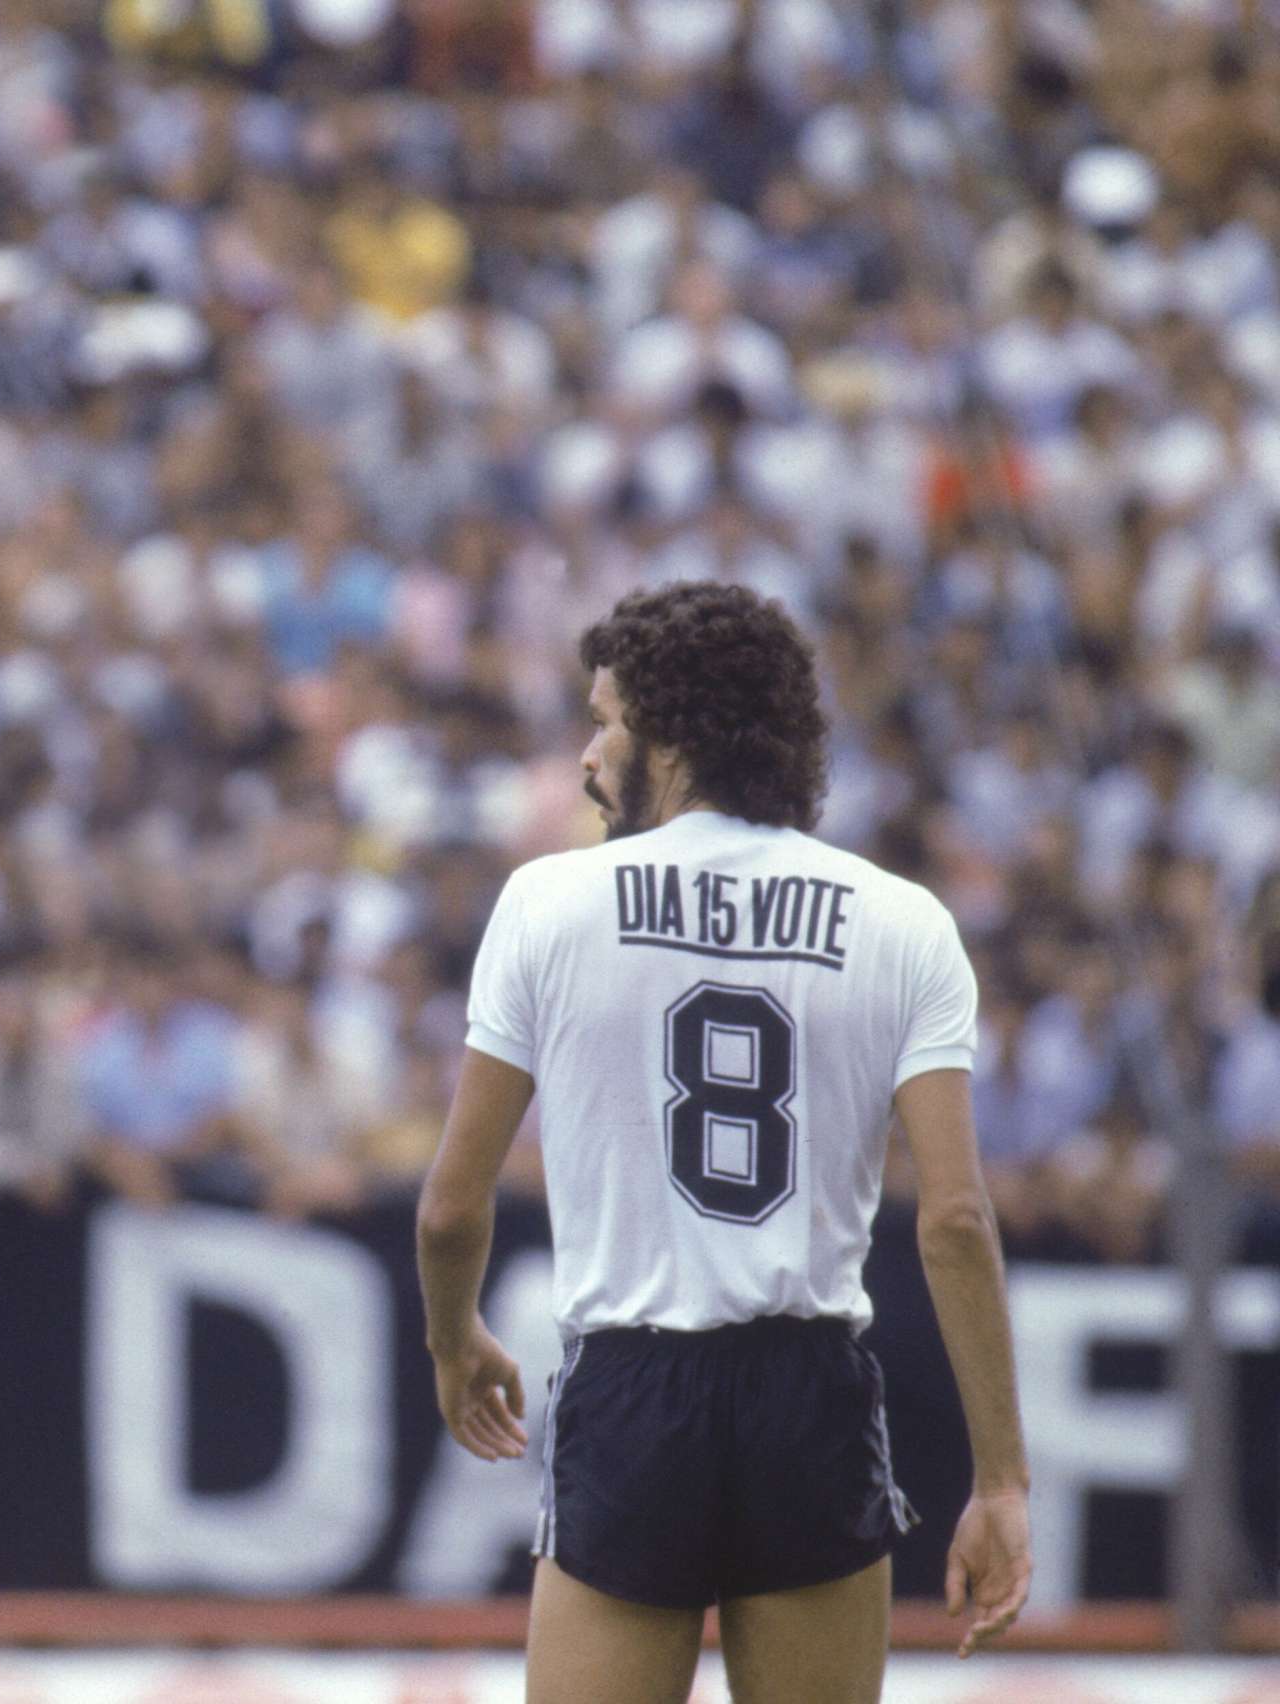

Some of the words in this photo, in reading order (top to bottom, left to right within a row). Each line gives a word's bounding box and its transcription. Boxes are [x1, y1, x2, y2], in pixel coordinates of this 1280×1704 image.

[615, 863, 685, 938] DIA
[692, 870, 739, 947] 15
[752, 875, 855, 958] VOTE
[664, 979, 796, 1227] 8
